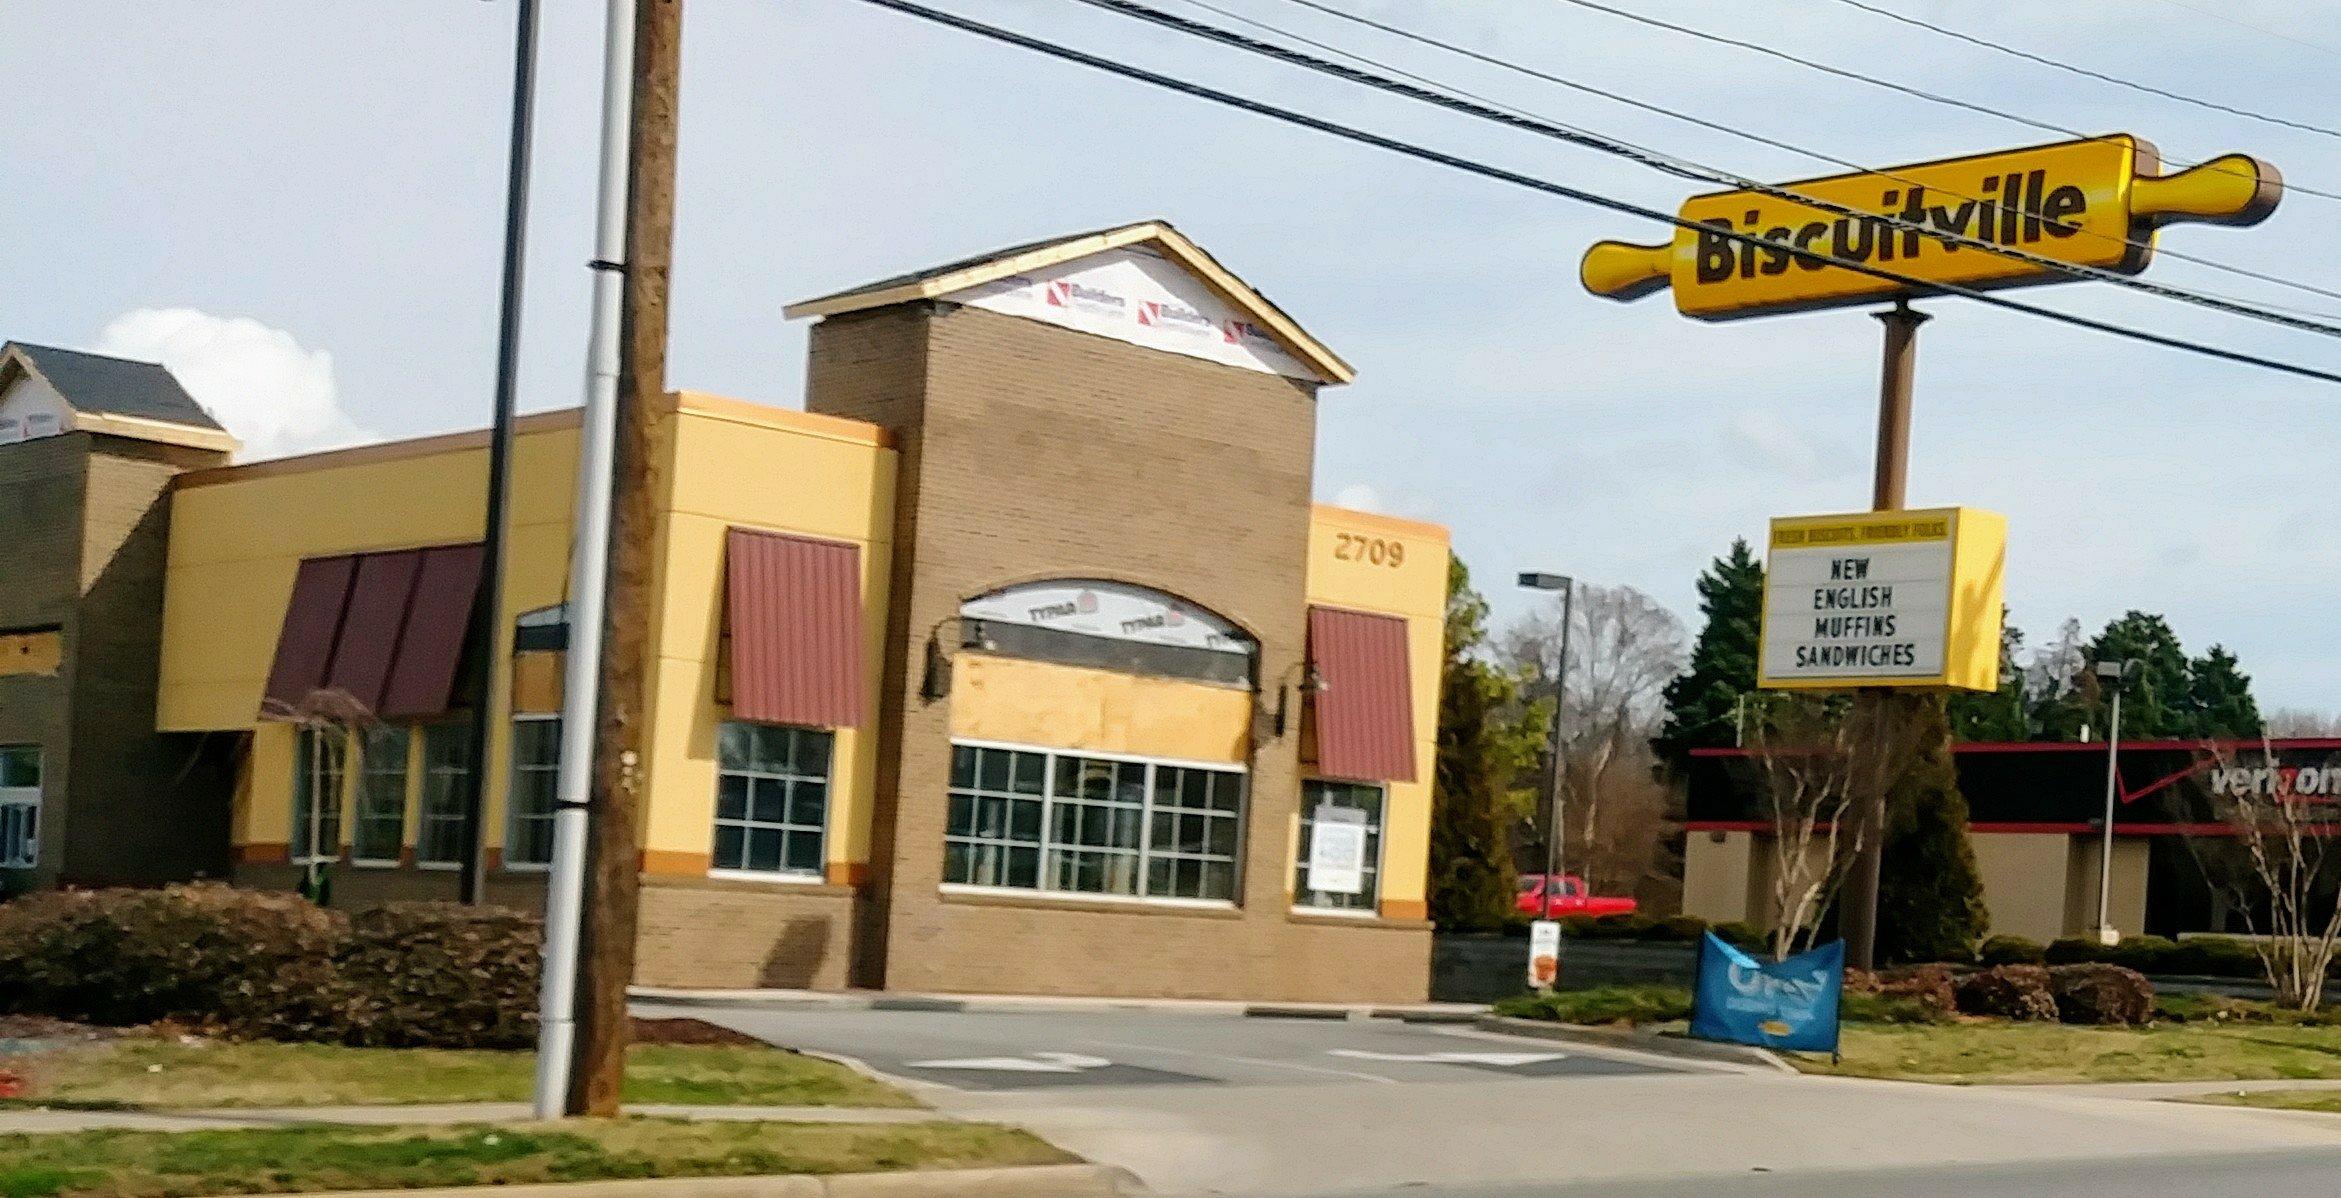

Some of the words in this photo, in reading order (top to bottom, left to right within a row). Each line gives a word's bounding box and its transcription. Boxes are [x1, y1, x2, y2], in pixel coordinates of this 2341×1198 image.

[1696, 169, 2088, 286] Biscuitville
[1334, 532, 1405, 568] 2709
[1830, 557, 1870, 580] NEW
[1813, 586, 1893, 610] ENGLISH
[1814, 614, 1896, 638] MUFFINS
[1795, 643, 1916, 669] SANDWICHES
